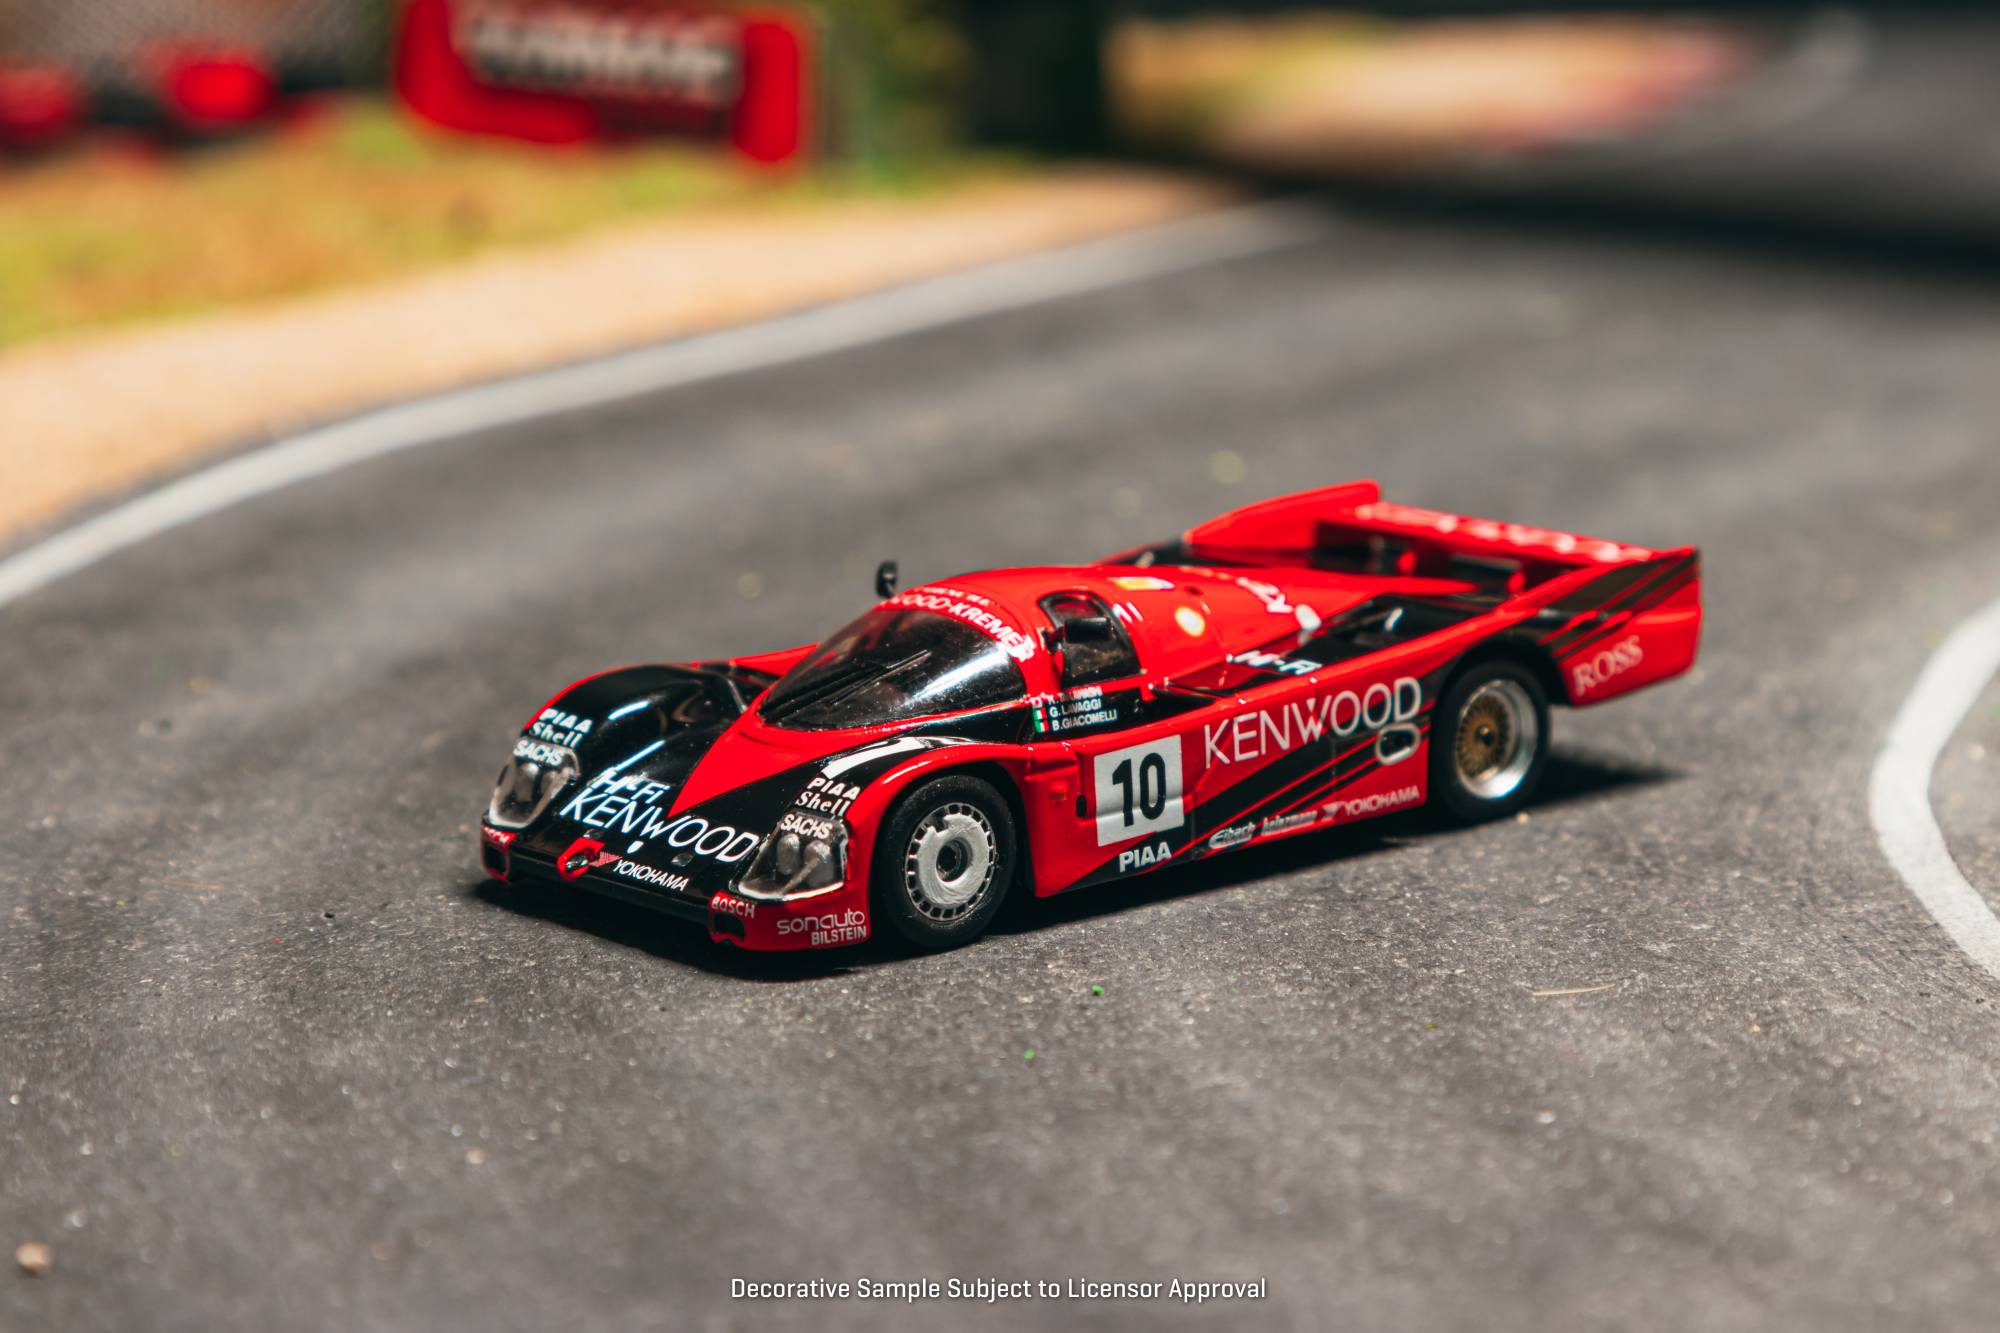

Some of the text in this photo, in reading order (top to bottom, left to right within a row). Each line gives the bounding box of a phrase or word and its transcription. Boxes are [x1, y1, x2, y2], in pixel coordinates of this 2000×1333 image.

[1573, 634, 1643, 696] ROSS
[532, 721, 583, 747] Shell
[539, 708, 592, 733] PIAA
[1204, 676, 1422, 769] KENWOOD
[513, 739, 565, 766] SACHS
[807, 777, 861, 800] PIAA
[1112, 752, 1166, 827] 10
[1345, 786, 1420, 816] YOKOHAMA
[795, 791, 851, 817] Shell
[559, 786, 760, 862] KENWOOD
[780, 813, 833, 839] SACHS
[1119, 841, 1172, 872] PIAA
[613, 859, 690, 891] YOKOHAMA
[711, 896, 756, 919] BOSCH
[776, 908, 865, 935] sonauto
[811, 925, 867, 946] BILSTEIN
